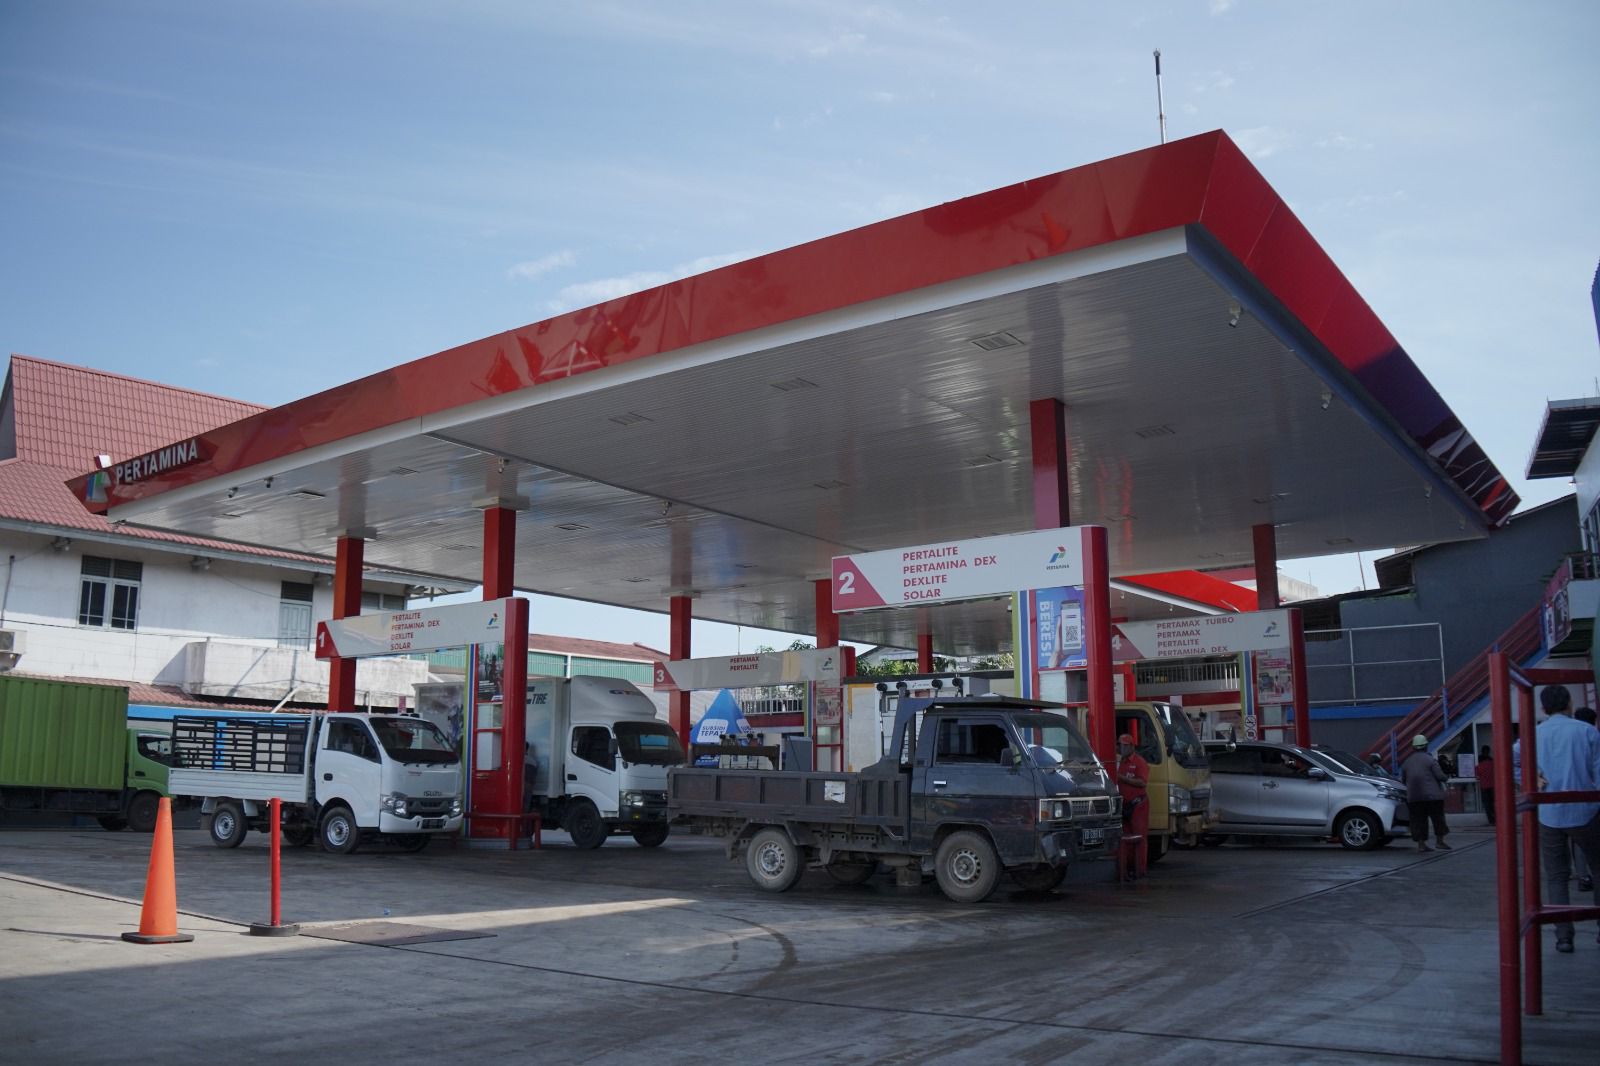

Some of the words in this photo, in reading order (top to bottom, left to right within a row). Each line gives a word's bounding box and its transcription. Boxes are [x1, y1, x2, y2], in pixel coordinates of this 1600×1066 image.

[115, 439, 198, 485] PERTAMINA
[903, 546, 959, 562] PERTALITE
[903, 559, 968, 575] PERTAMINA
[974, 555, 998, 567] DEX
[838, 571, 856, 595] 2
[903, 574, 948, 588] DEXLITE
[903, 588, 942, 601] SOLAR
[391, 611, 422, 623] PERTALITE
[1156, 619, 1201, 631] PERTAMAX
[1205, 616, 1235, 626] TURBO
[391, 621, 425, 632] PERTAMINA
[427, 619, 441, 628] DEX
[1039, 600, 1053, 658] BERES!
[317, 631, 326, 648] 1
[391, 631, 415, 641] DEXLITE
[1157, 629, 1201, 639] PERTAMAX
[390, 641, 411, 651] SOLAR
[1111, 634, 1122, 650] 4
[1157, 638, 1200, 649] PERTALITE
[1157, 647, 1207, 657] PERTAMINA
[1211, 645, 1229, 653] DEX
[729, 655, 760, 664] PERTAMAX
[729, 663, 759, 672] PERTALITE
[656, 669, 665, 683] 3
